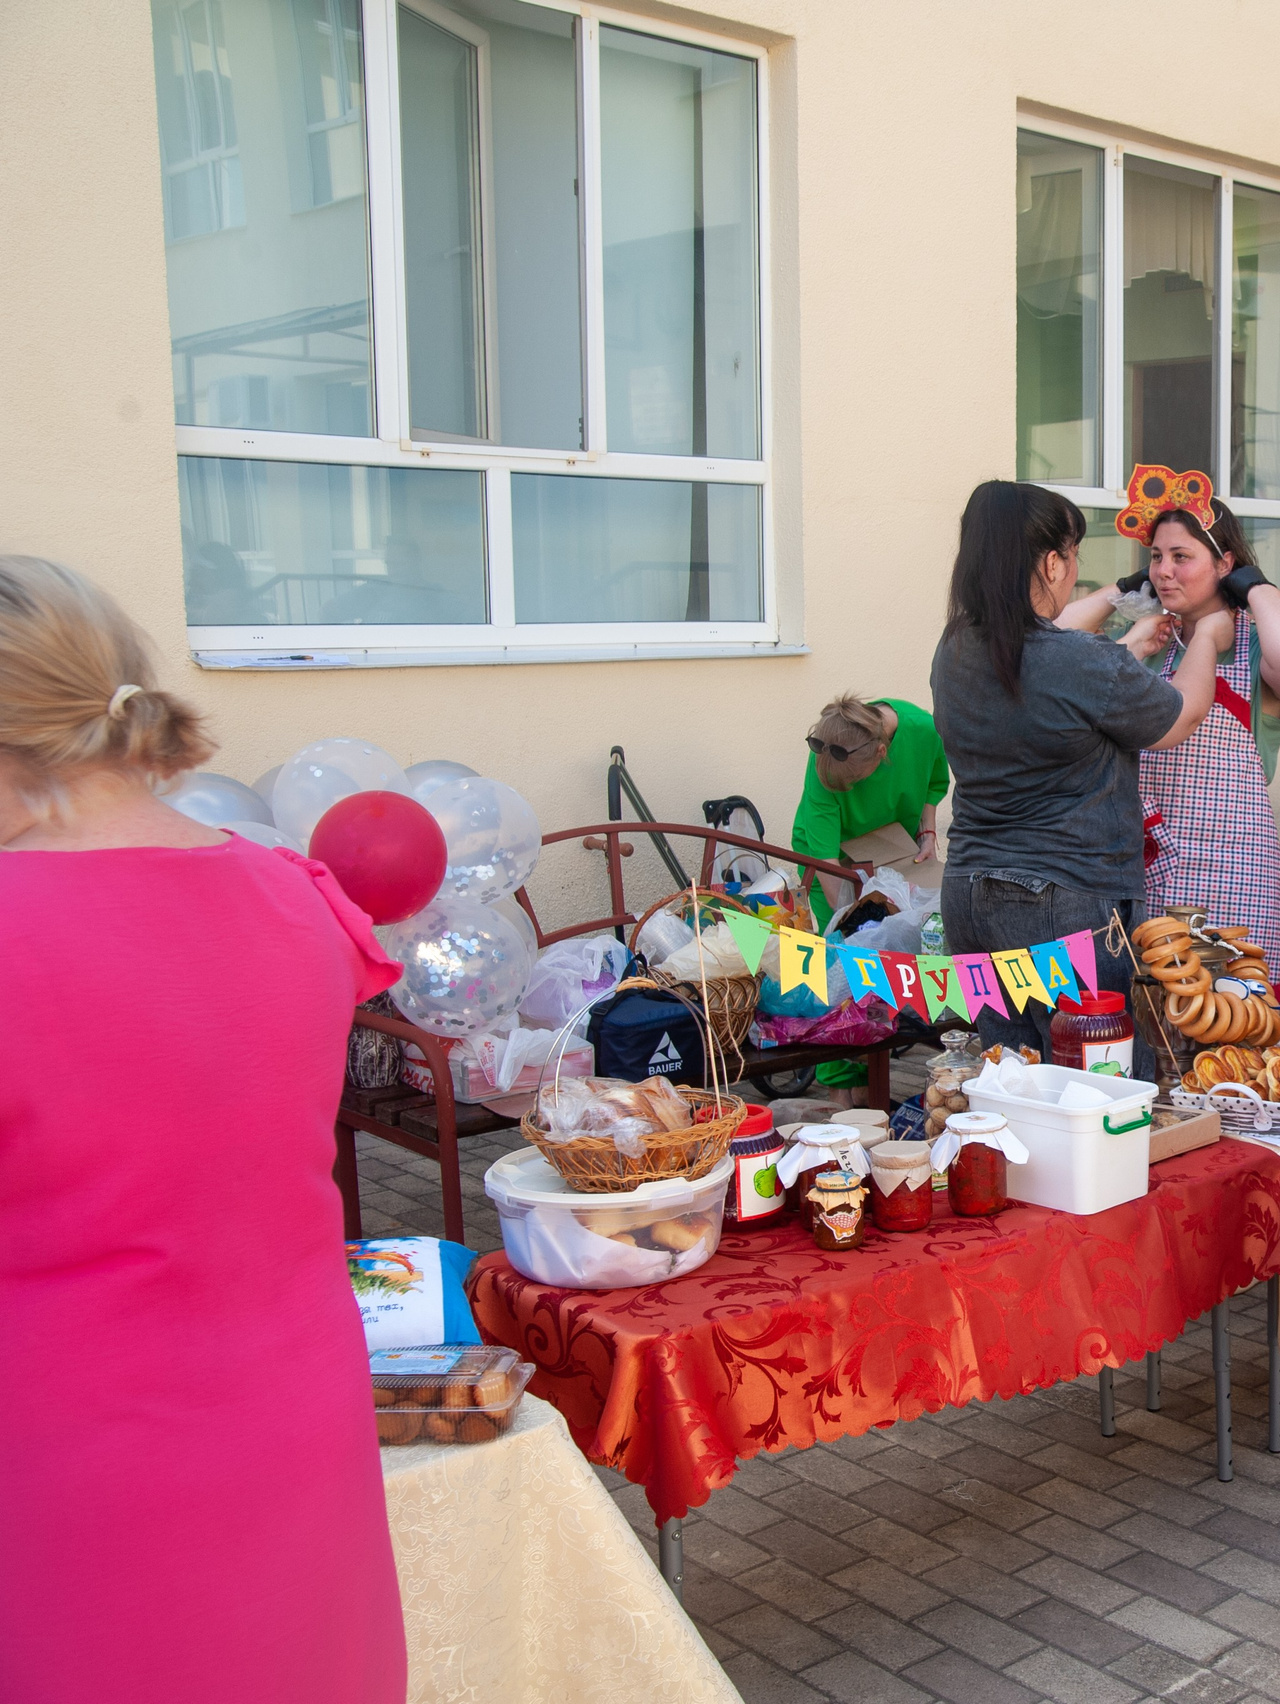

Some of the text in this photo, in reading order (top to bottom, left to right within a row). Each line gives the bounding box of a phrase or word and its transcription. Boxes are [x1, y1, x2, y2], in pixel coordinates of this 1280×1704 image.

[796, 944, 1069, 1003] 7 ГРУППА
[648, 1062, 682, 1076] BAUER
